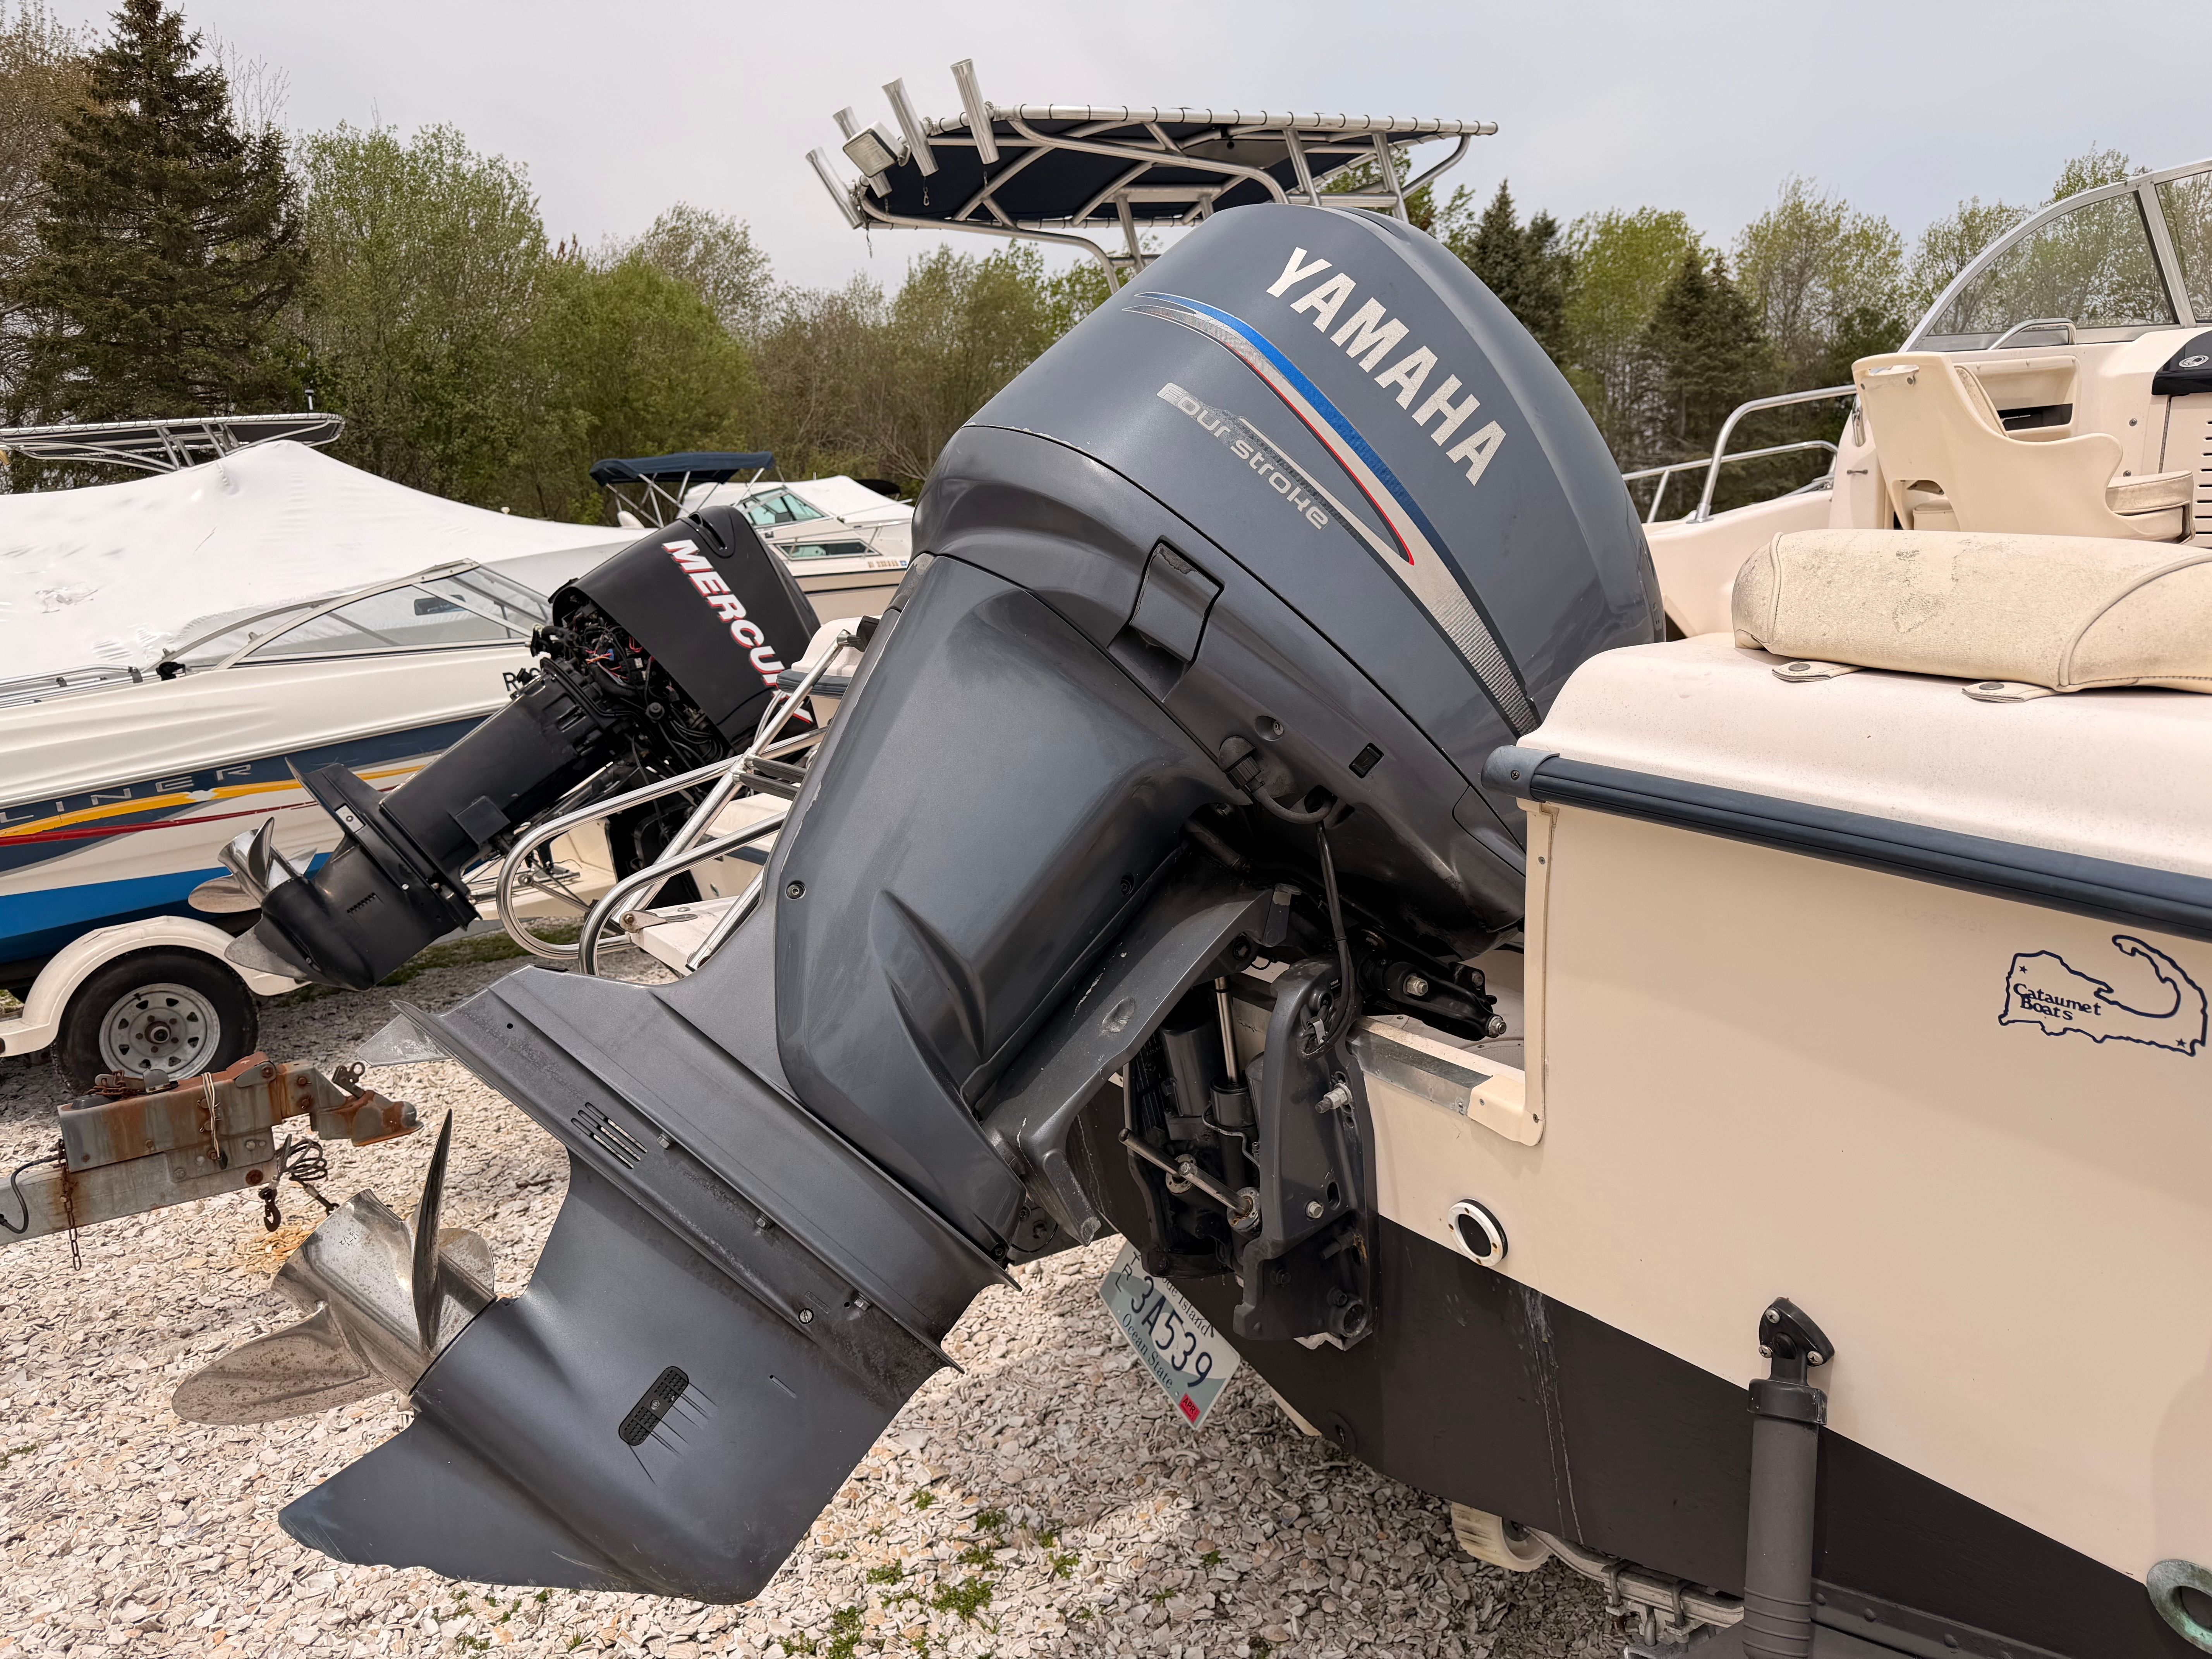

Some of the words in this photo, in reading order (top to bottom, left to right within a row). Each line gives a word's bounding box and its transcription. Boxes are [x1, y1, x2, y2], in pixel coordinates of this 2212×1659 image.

[1266, 247, 1506, 486] YAMAHA
[0, 764, 252, 823] LINER
[2013, 983, 2101, 1016] Cataumet
[2020, 994, 2073, 1020] Boats
[1131, 1276, 1212, 1388] 3A539
[1178, 1295, 1212, 1337] Island
[1123, 1313, 1148, 1356] Ocean
[1147, 1351, 1173, 1388] State
[1182, 1397, 1196, 1414] APR
